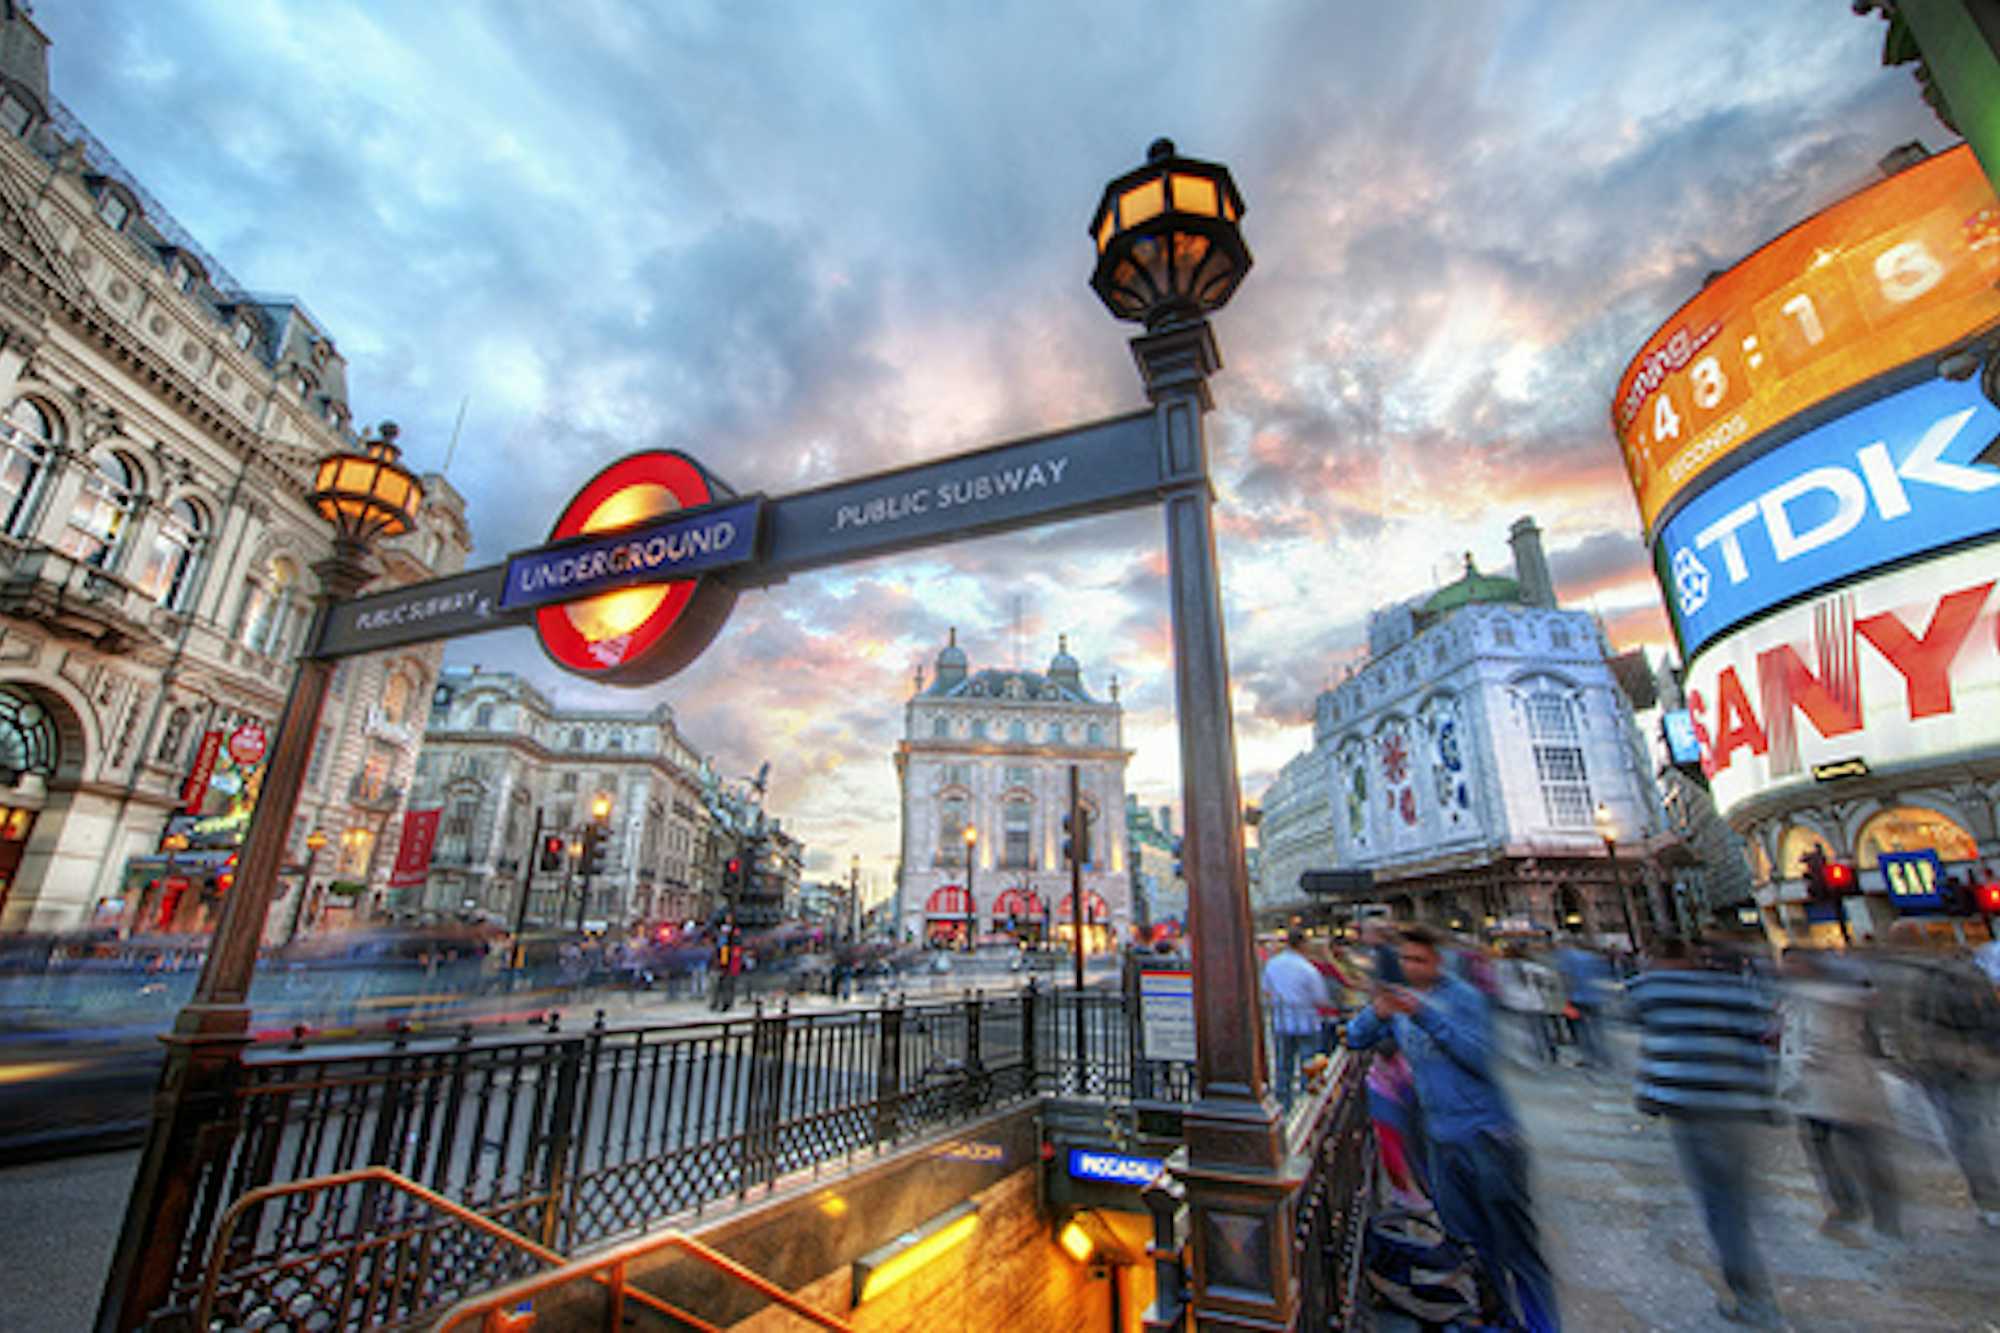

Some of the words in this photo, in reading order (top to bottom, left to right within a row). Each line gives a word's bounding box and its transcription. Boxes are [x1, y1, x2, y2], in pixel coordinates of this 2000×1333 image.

[520, 521, 737, 591] UNDERGROUND
[836, 489, 929, 529] PUBLIC
[937, 457, 1069, 508] SUBWAY
[1693, 405, 2000, 585] TDK
[1688, 581, 2000, 781] SANY
